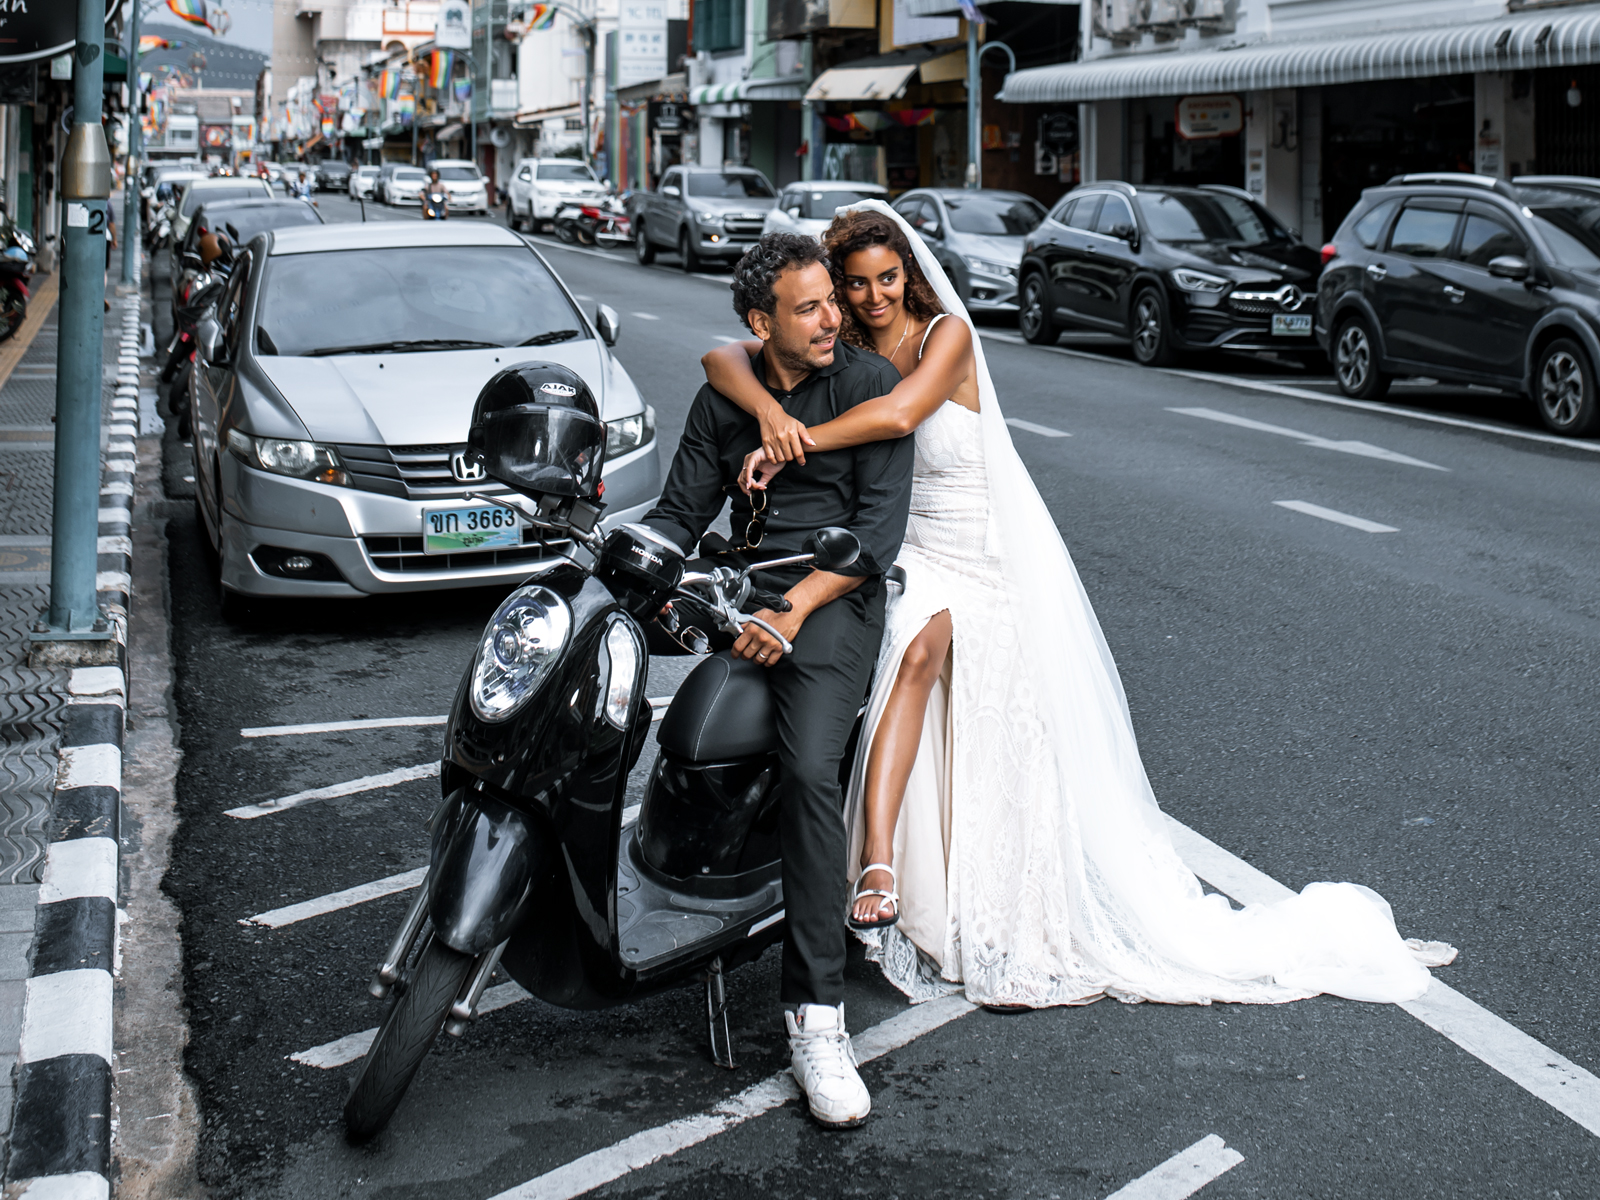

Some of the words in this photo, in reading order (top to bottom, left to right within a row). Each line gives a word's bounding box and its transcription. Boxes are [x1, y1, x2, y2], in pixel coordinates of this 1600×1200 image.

[88, 209, 105, 235] 2
[430, 512, 459, 533] ขก
[467, 508, 516, 531] 3663
[631, 545, 663, 567] HONDA
